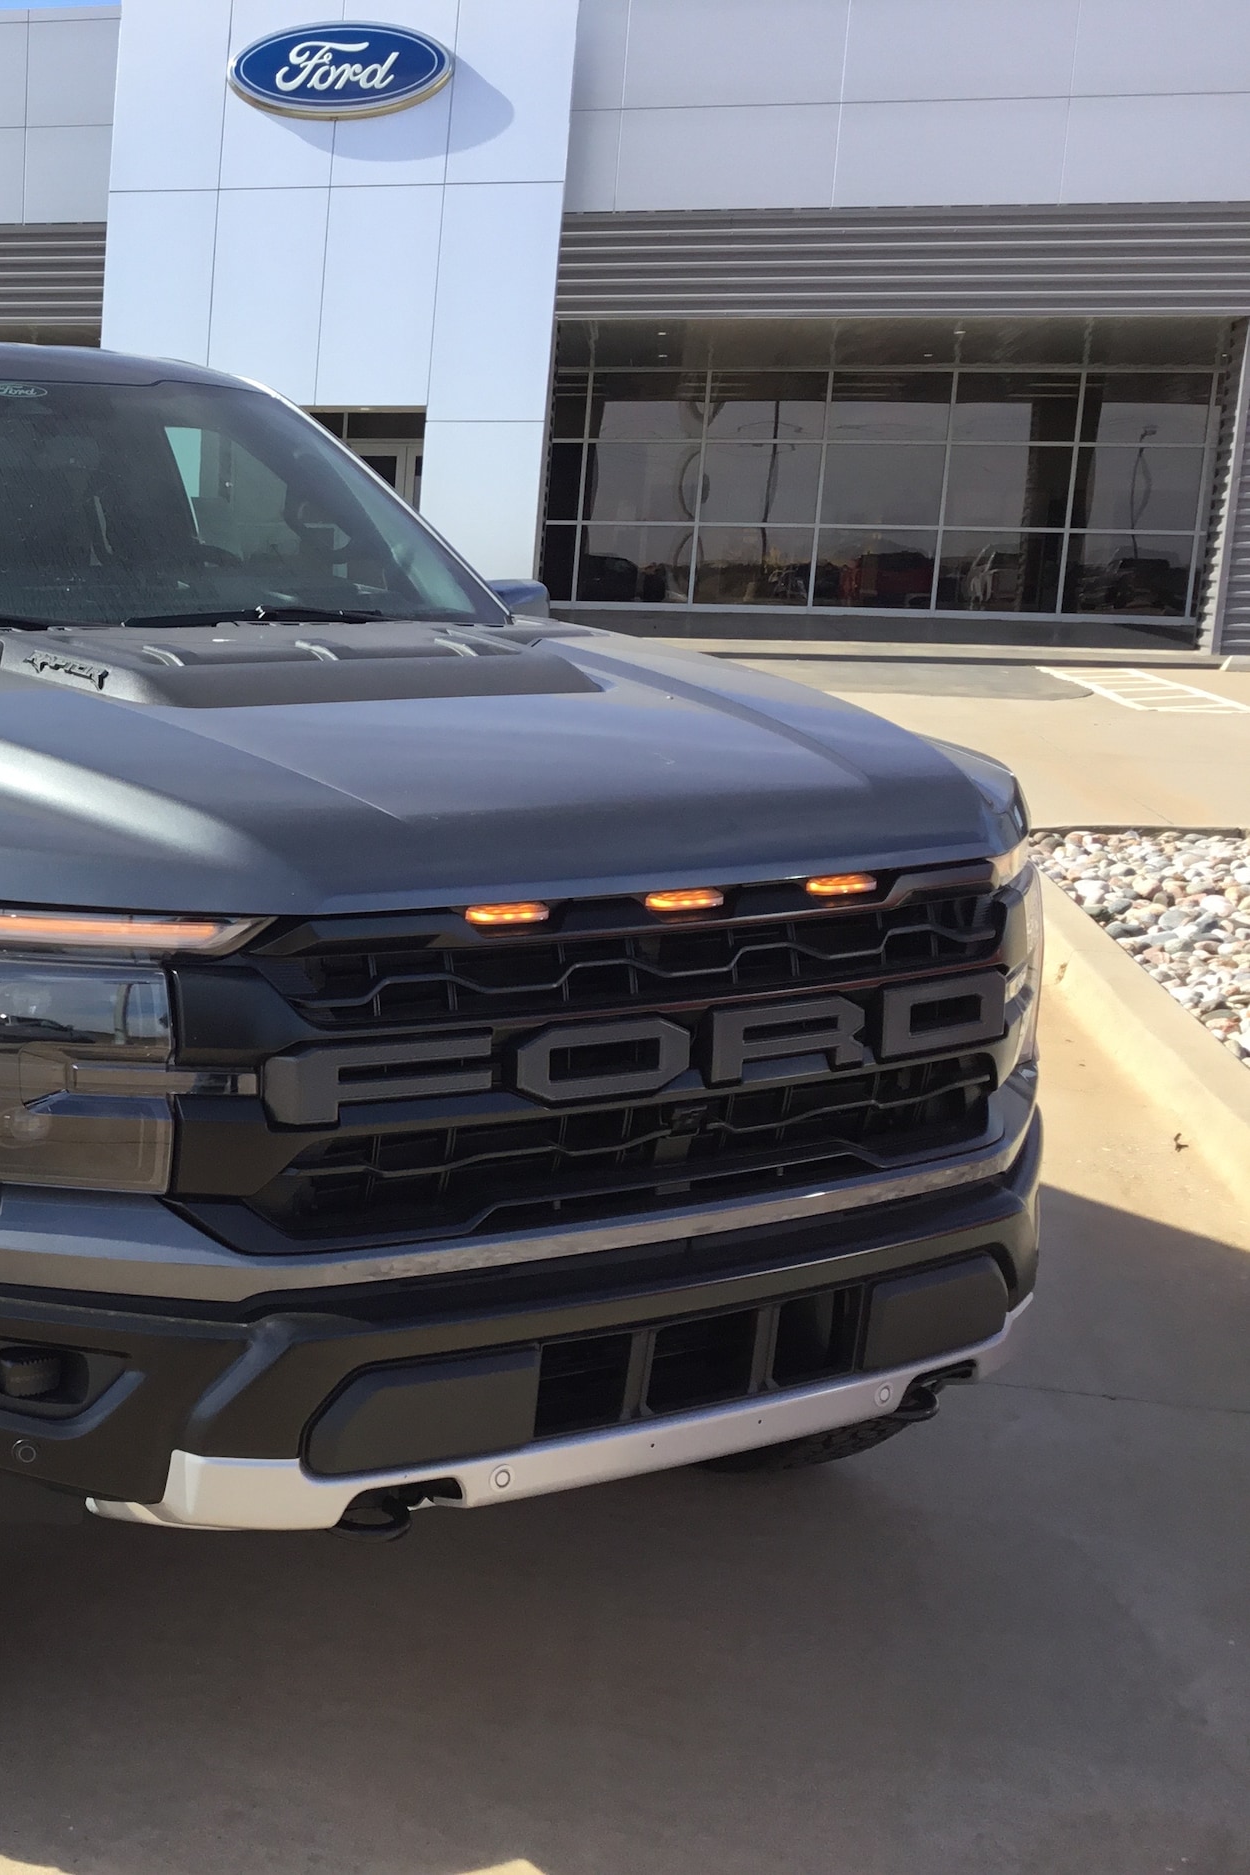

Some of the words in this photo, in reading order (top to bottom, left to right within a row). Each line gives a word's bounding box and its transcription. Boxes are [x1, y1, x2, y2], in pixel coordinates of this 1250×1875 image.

[275, 41, 400, 92] Ford
[23, 650, 111, 691] RAPTOR
[263, 966, 1007, 1127] FORD
